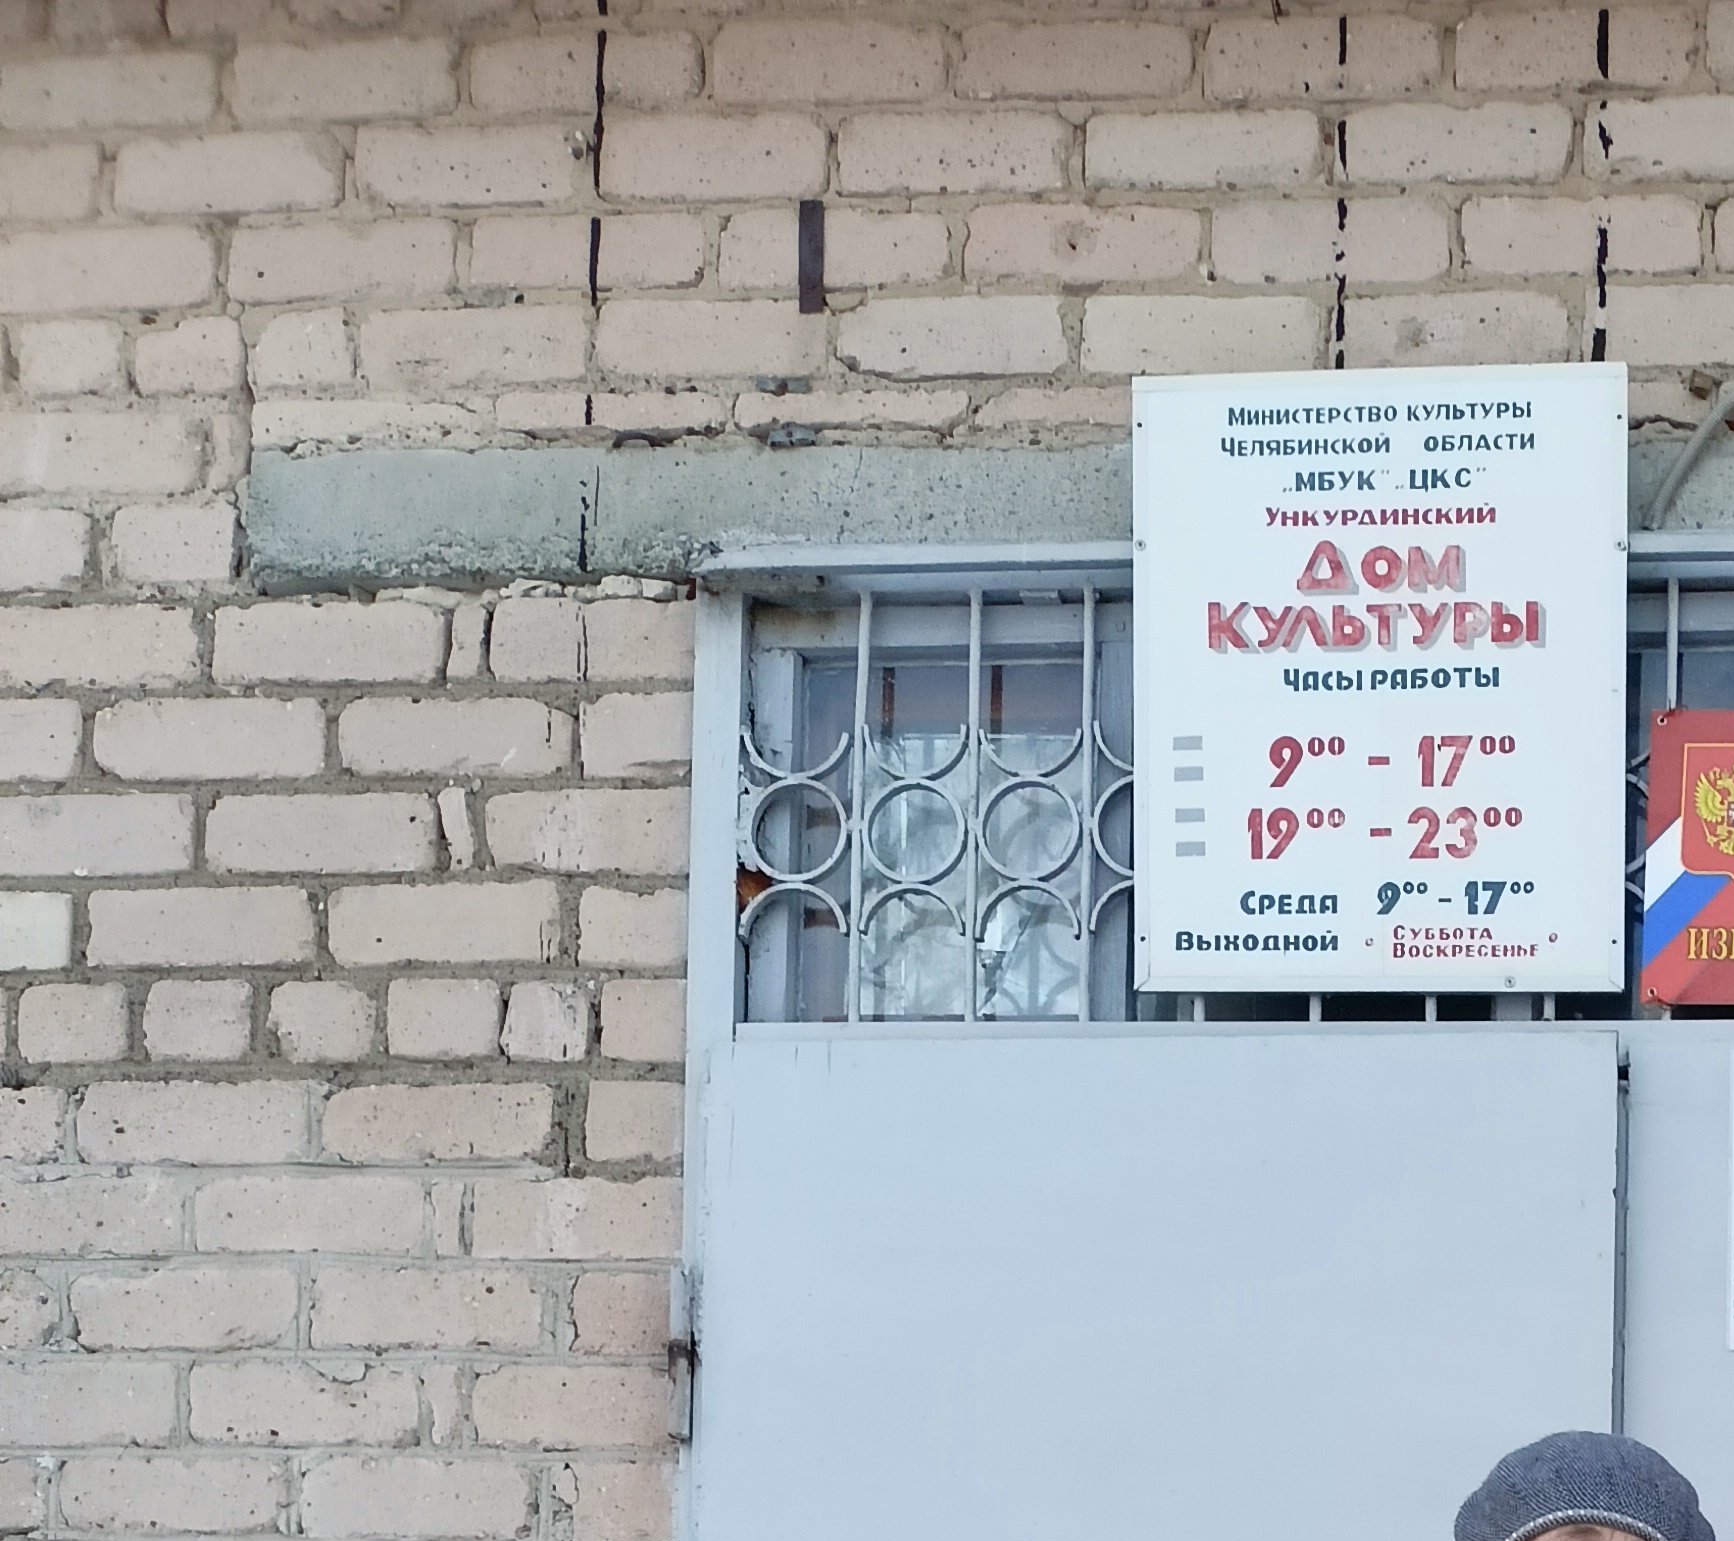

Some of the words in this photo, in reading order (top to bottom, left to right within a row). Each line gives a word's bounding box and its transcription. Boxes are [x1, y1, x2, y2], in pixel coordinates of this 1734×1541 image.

[1406, 401, 1532, 422] КУЛЬТУРЫ
[1220, 432, 1391, 457] ЧЕЛЯБИНСКОЙ
[1423, 432, 1535, 451] ОБЛАСТИ
[1296, 540, 1466, 596] ДОМ
[1208, 600, 1546, 654] КУЛЬТУРЫ
[1370, 666, 1500, 691] РАБОТЫ
[1393, 925, 1493, 941] СУББОТА
